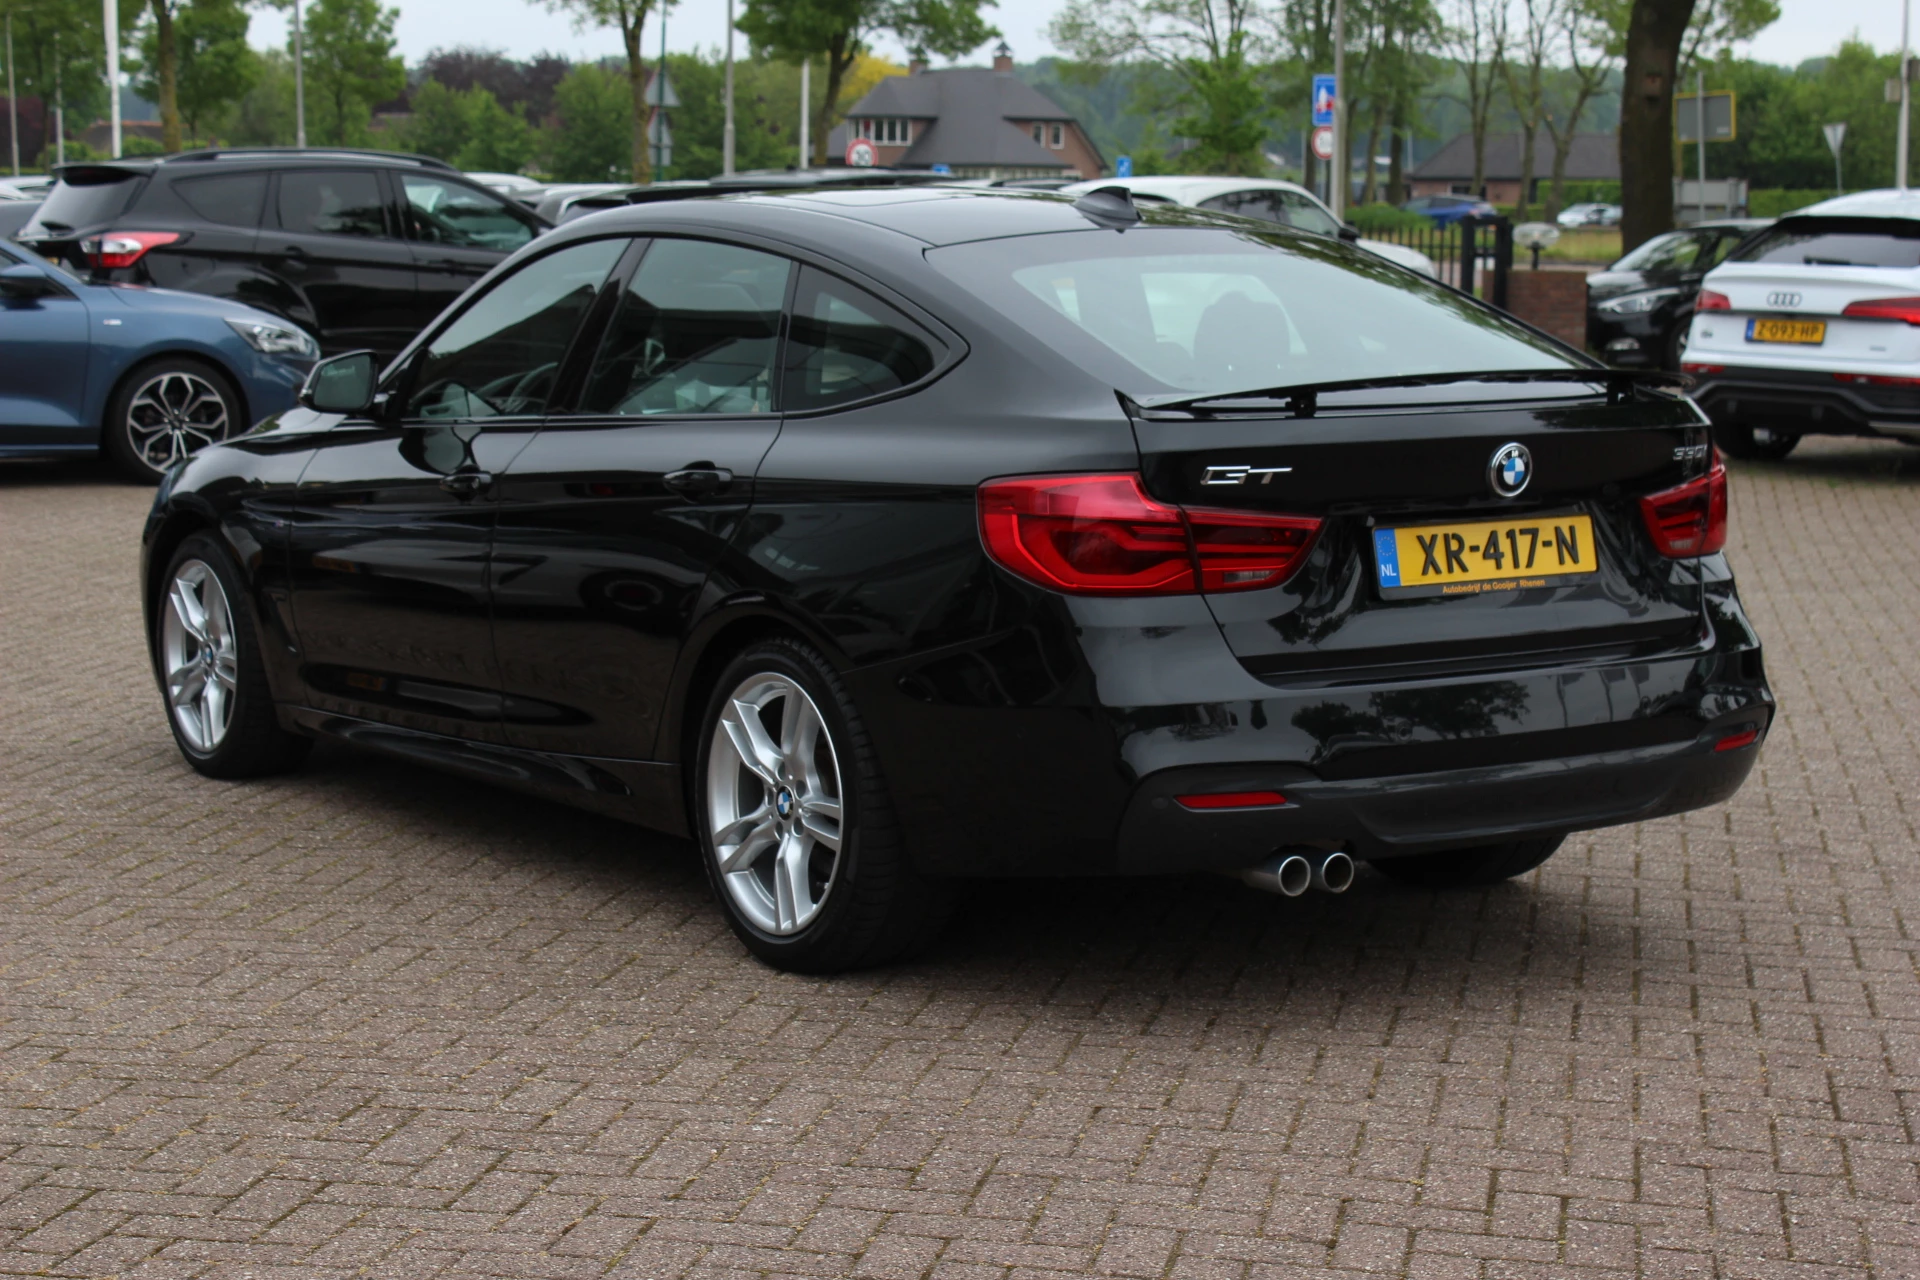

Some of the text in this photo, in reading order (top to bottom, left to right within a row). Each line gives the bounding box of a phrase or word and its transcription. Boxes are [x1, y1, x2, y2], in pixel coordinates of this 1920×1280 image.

[1200, 465, 1293, 485] GT
[1416, 525, 1580, 576] XR-417-N
[1380, 563, 1397, 577] NL
[1482, 582, 1492, 591] de
